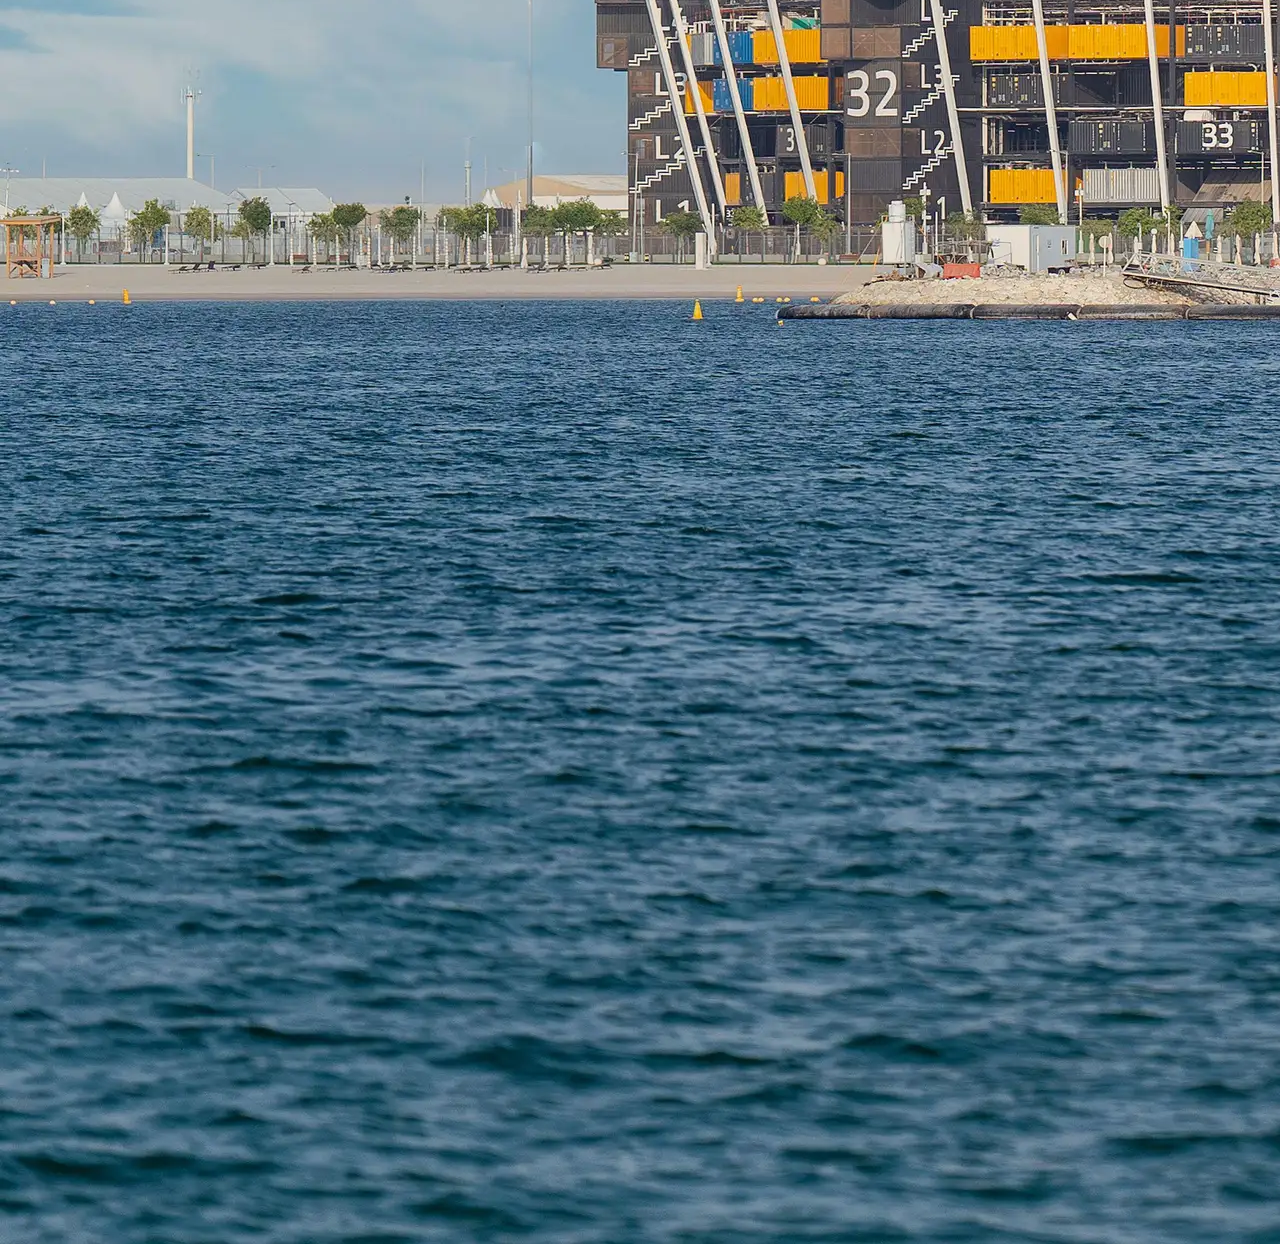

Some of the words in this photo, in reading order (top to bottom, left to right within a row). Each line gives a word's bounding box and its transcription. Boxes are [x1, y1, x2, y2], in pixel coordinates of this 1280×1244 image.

[656, 72, 687, 96] L3
[921, 64, 945, 88] L3
[847, 70, 898, 117] 32
[656, 136, 687, 159] L2
[921, 130, 945, 154] L2
[1202, 123, 1233, 148] 33
